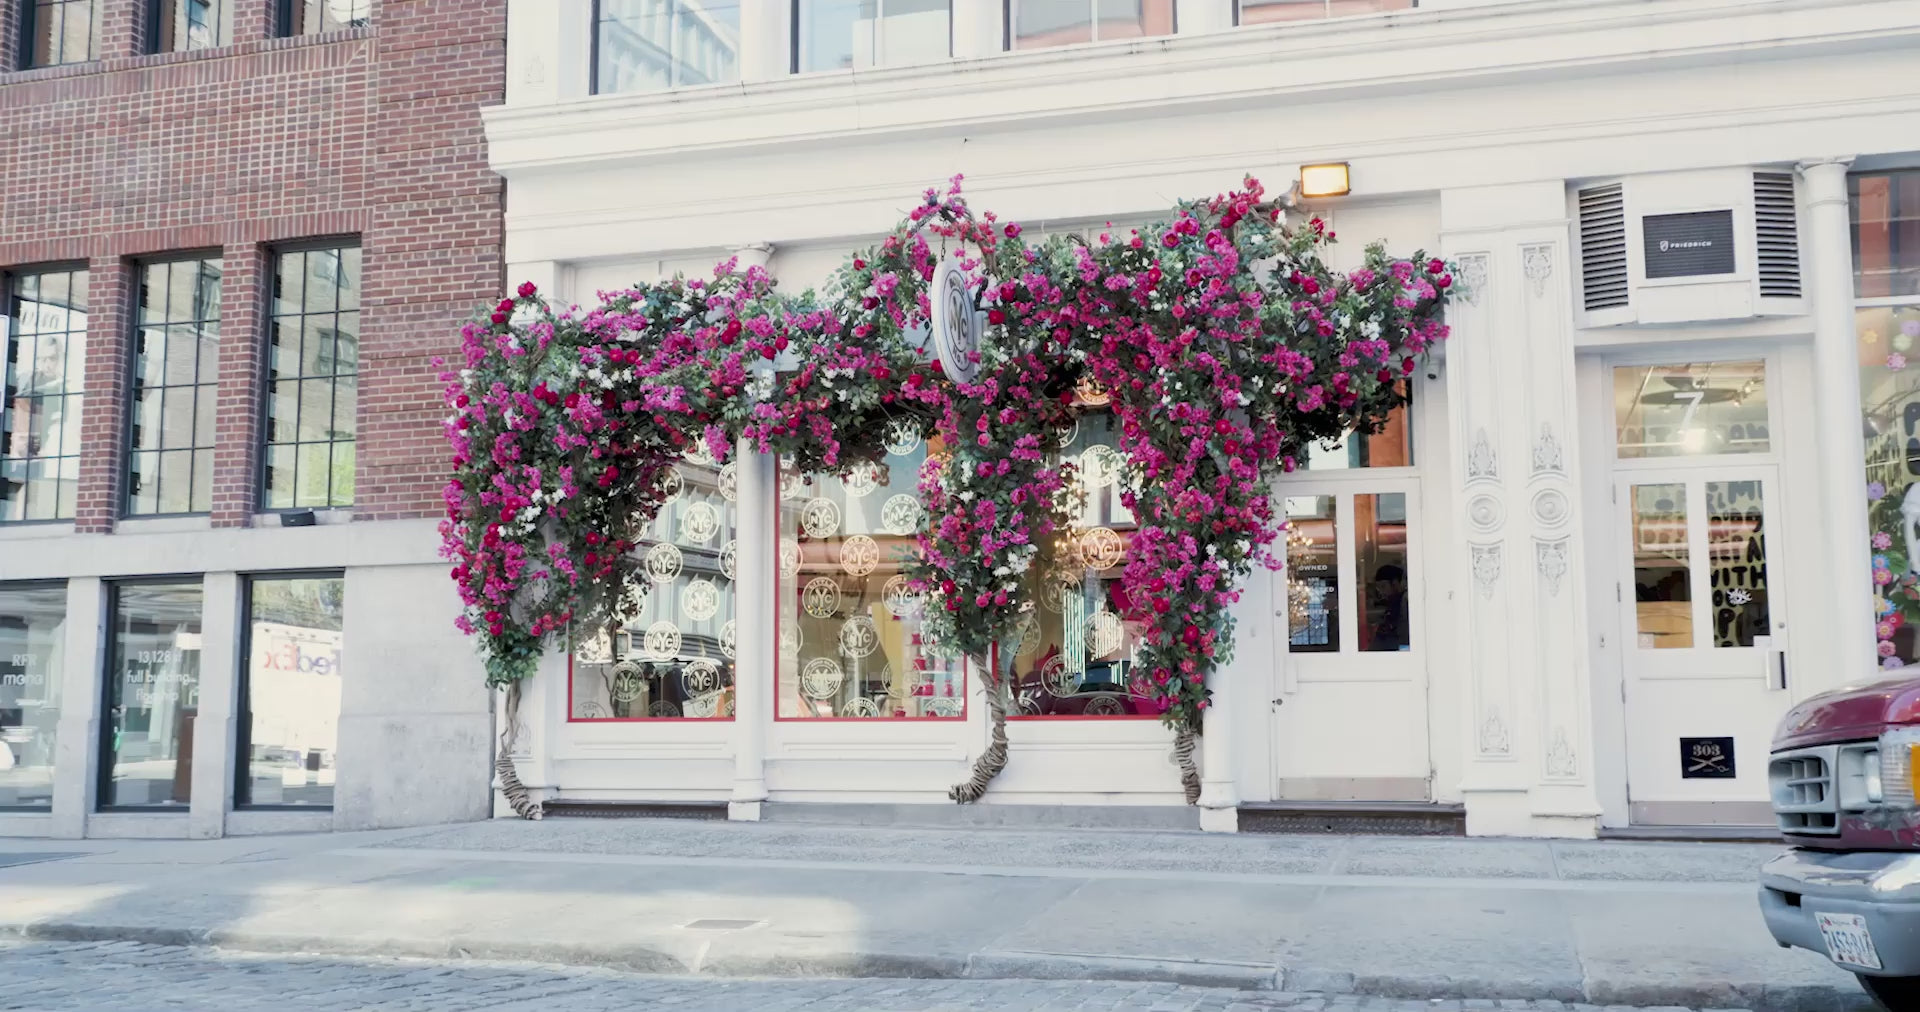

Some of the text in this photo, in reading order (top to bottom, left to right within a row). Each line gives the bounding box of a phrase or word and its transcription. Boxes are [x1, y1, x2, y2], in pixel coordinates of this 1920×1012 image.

[1669, 240, 1712, 249] FRIEDRICH
[1674, 391, 1704, 431] 7
[691, 512, 711, 532] NYC
[811, 508, 831, 529] NYC
[849, 546, 871, 566] NYC
[1088, 538, 1113, 559] NYC
[654, 553, 674, 573] NYC
[811, 588, 832, 608] NYC
[890, 585, 913, 605] NYC
[653, 632, 674, 652] NYC
[138, 650, 171, 666] 13,128
[127, 669, 144, 683] full
[617, 672, 636, 691] NYC
[690, 671, 711, 692] NYC
[1052, 666, 1073, 687] NYC
[1693, 744, 1720, 757] 303
